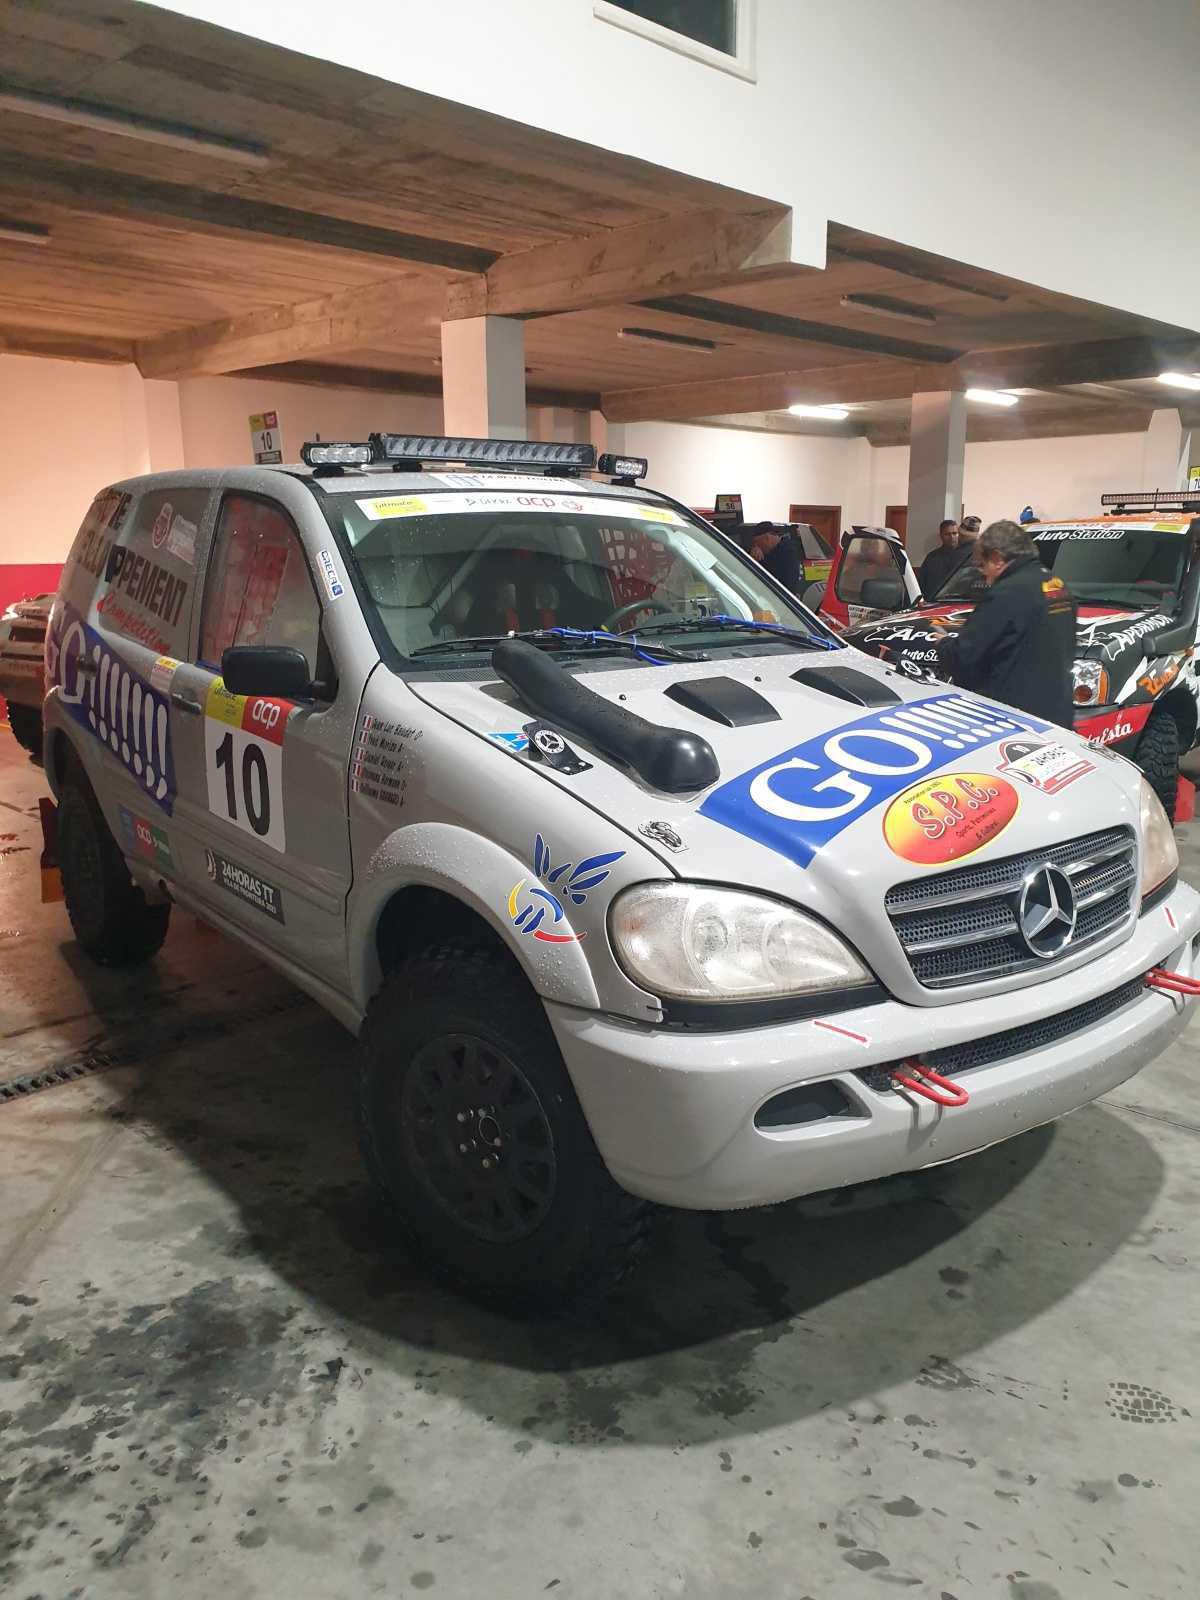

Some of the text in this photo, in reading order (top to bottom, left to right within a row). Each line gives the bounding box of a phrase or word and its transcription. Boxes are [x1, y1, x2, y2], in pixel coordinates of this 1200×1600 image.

[261, 431, 272, 450] 10
[1033, 528, 1126, 541] Auto Station
[252, 699, 281, 730] acp
[216, 732, 271, 836] 10
